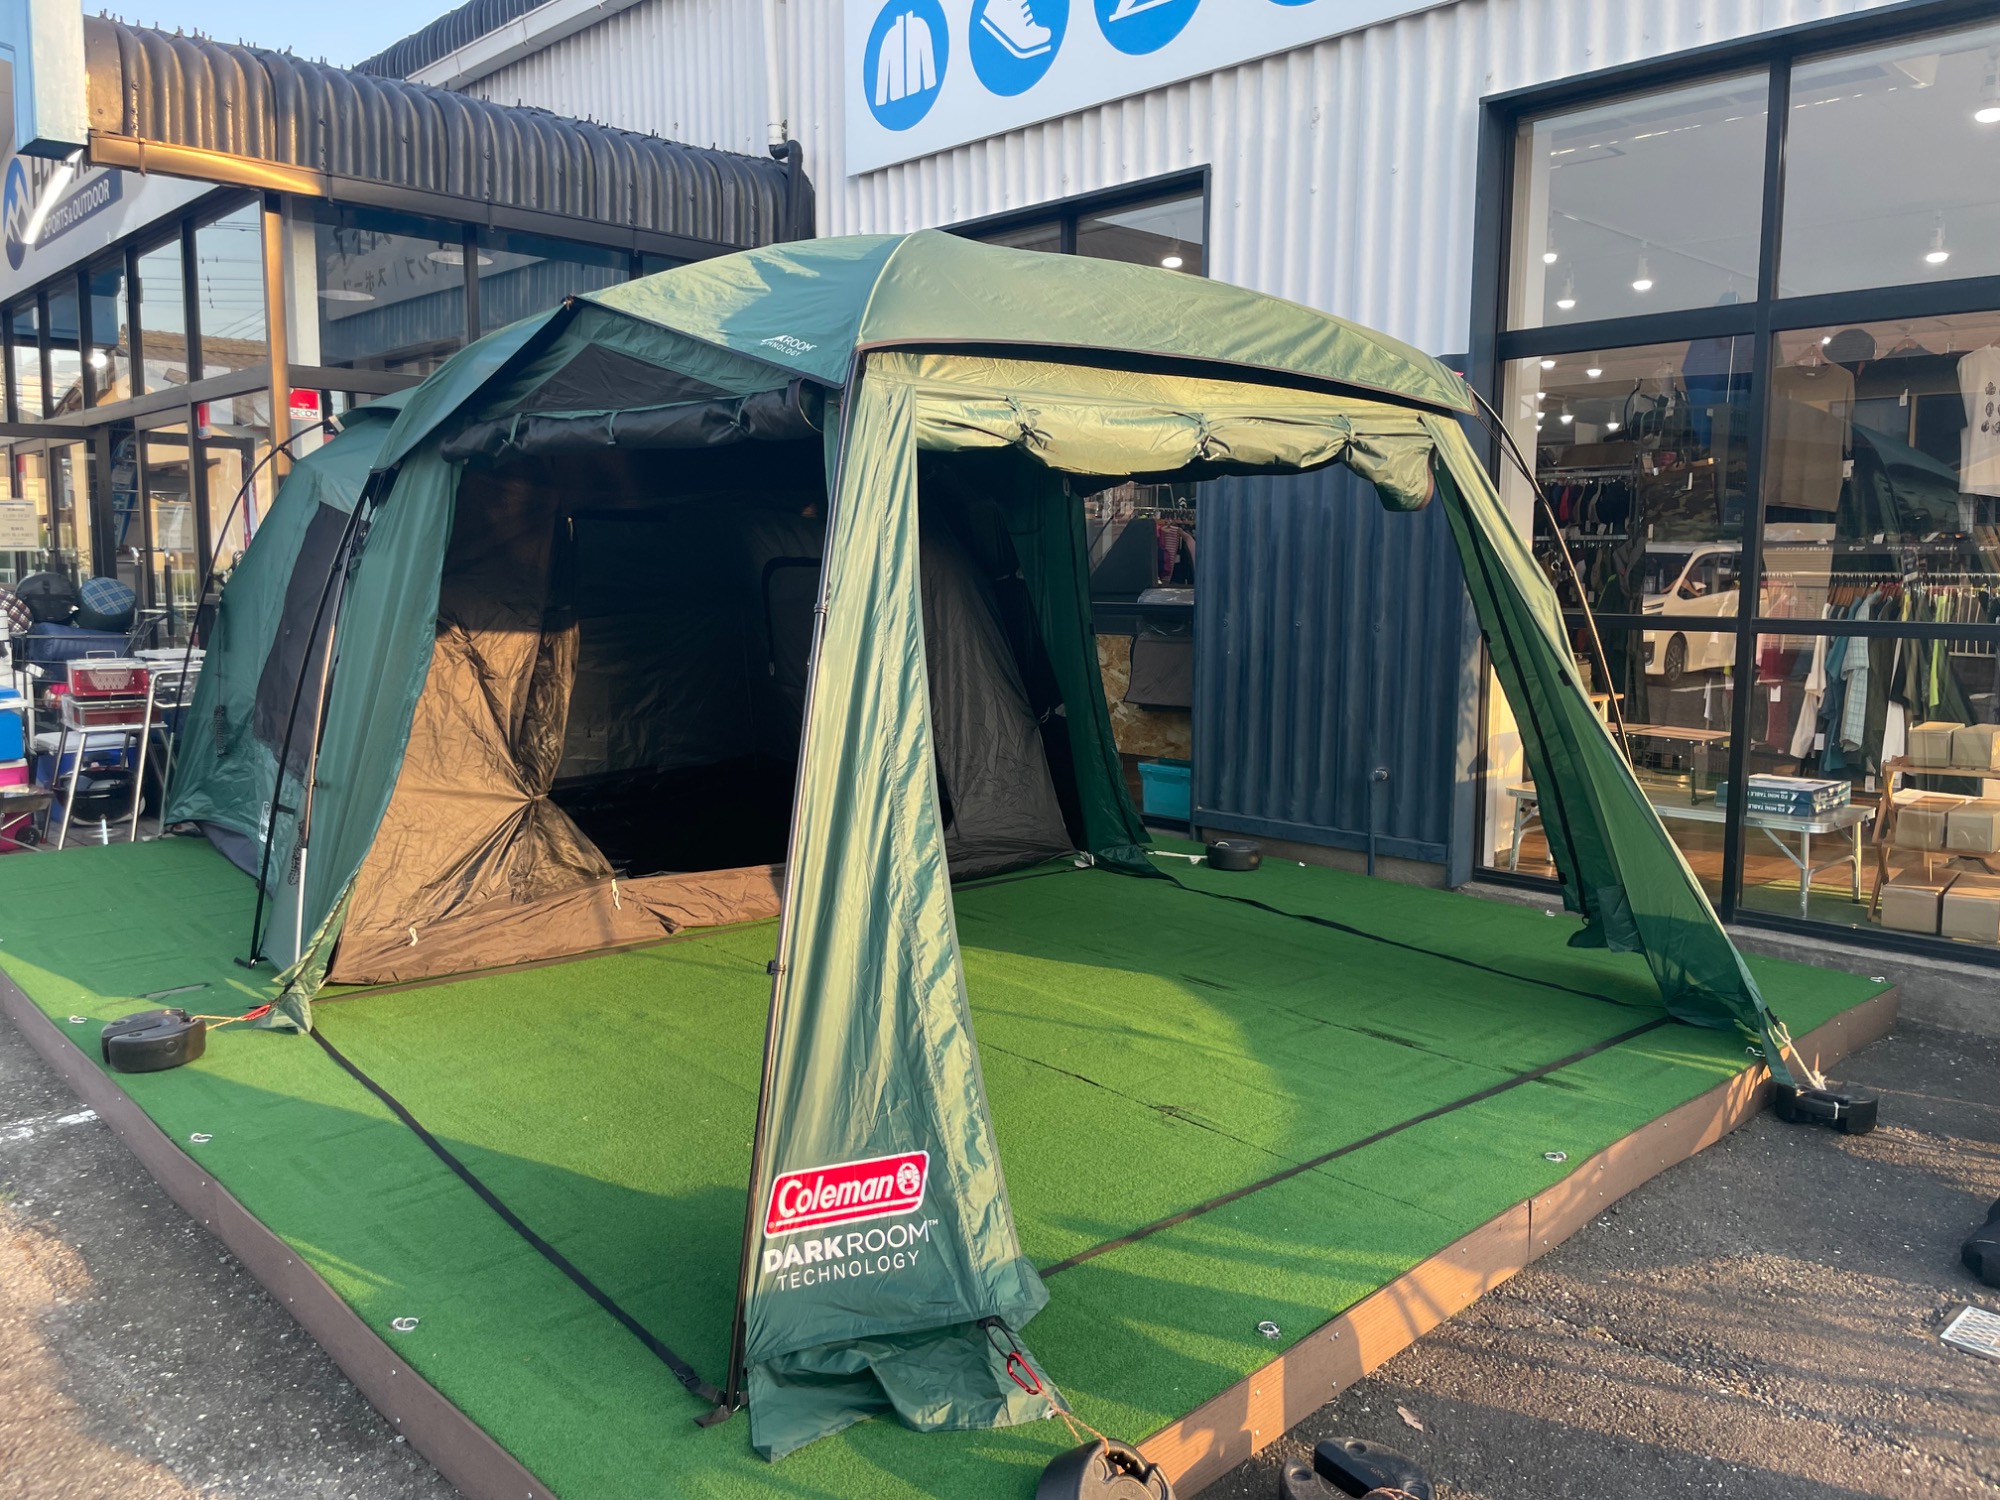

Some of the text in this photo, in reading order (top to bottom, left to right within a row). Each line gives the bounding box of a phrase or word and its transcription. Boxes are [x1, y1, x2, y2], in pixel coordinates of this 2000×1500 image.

[290, 409, 318, 418] SECOM
[777, 1174, 895, 1218] Coleman
[777, 1250, 920, 1292] TECHNOLOGY
